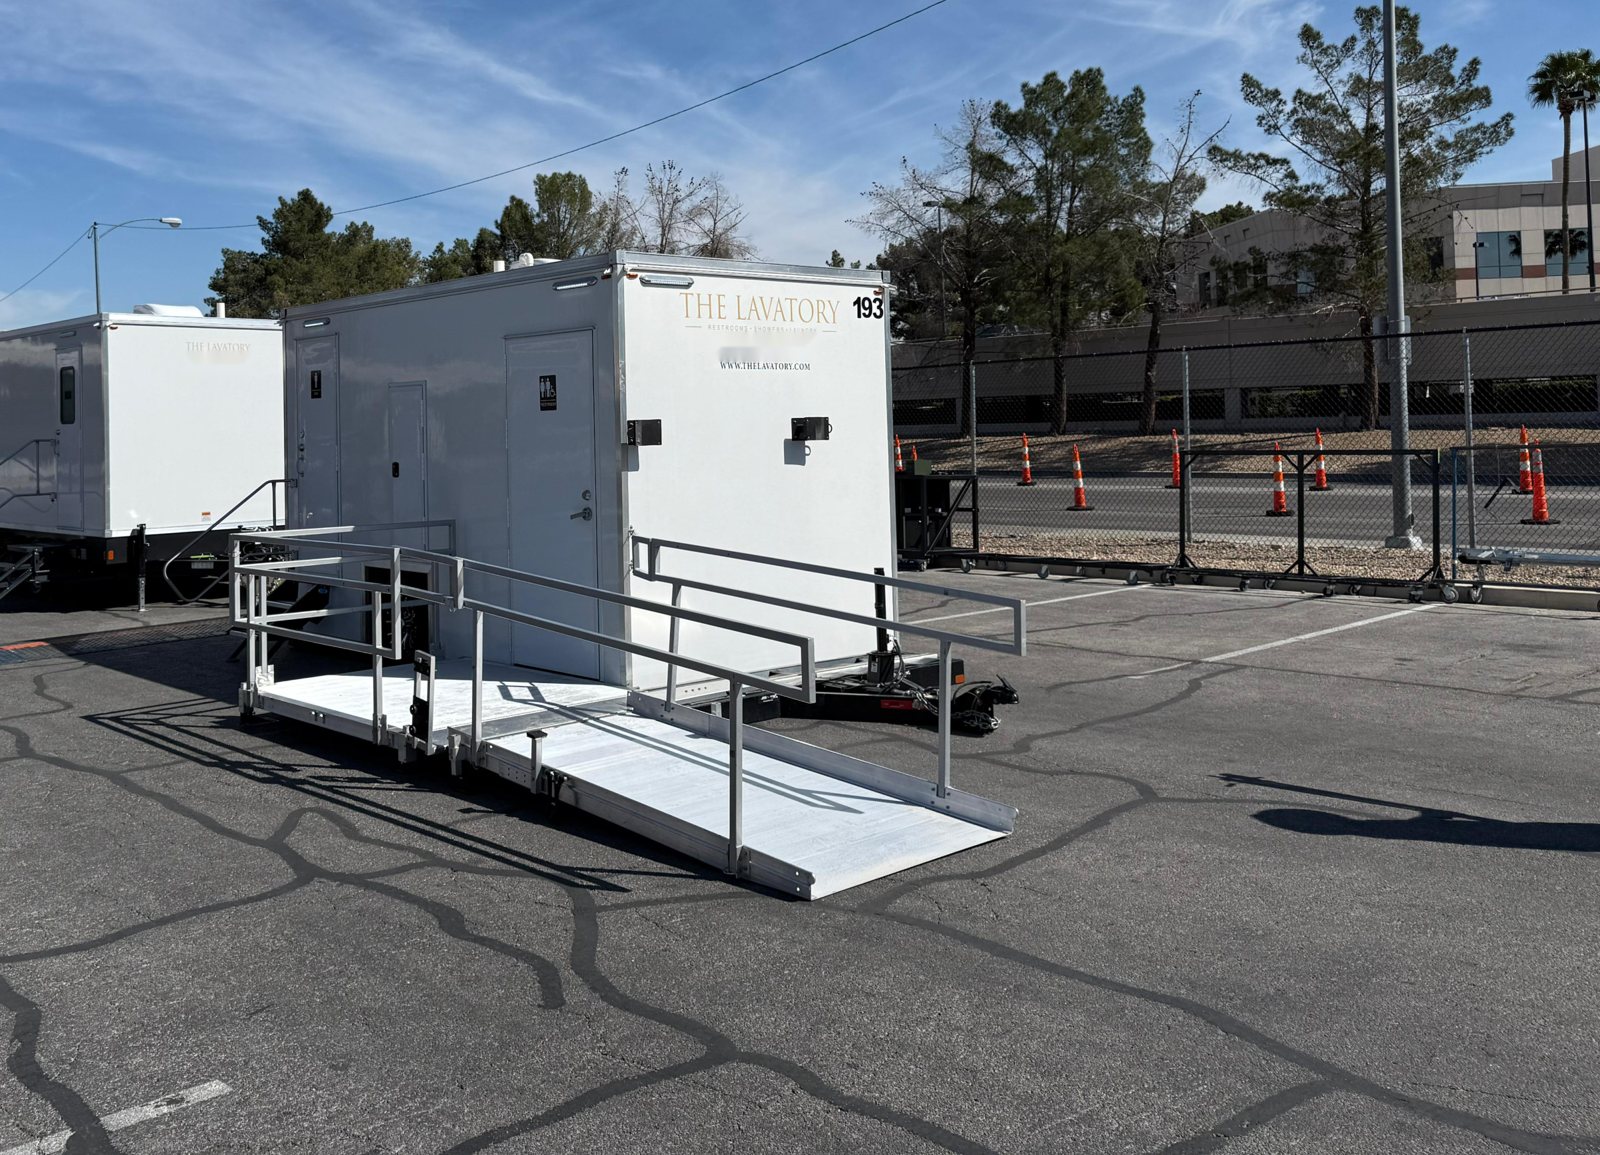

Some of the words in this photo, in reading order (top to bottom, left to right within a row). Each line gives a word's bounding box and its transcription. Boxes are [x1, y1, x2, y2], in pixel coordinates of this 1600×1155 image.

[680, 292, 727, 320] THE
[736, 295, 841, 324] LAVATORY
[852, 296, 884, 319] 193
[207, 342, 251, 353] LAVATORY
[720, 360, 811, 371] WWW.THELAVATORY.COM
